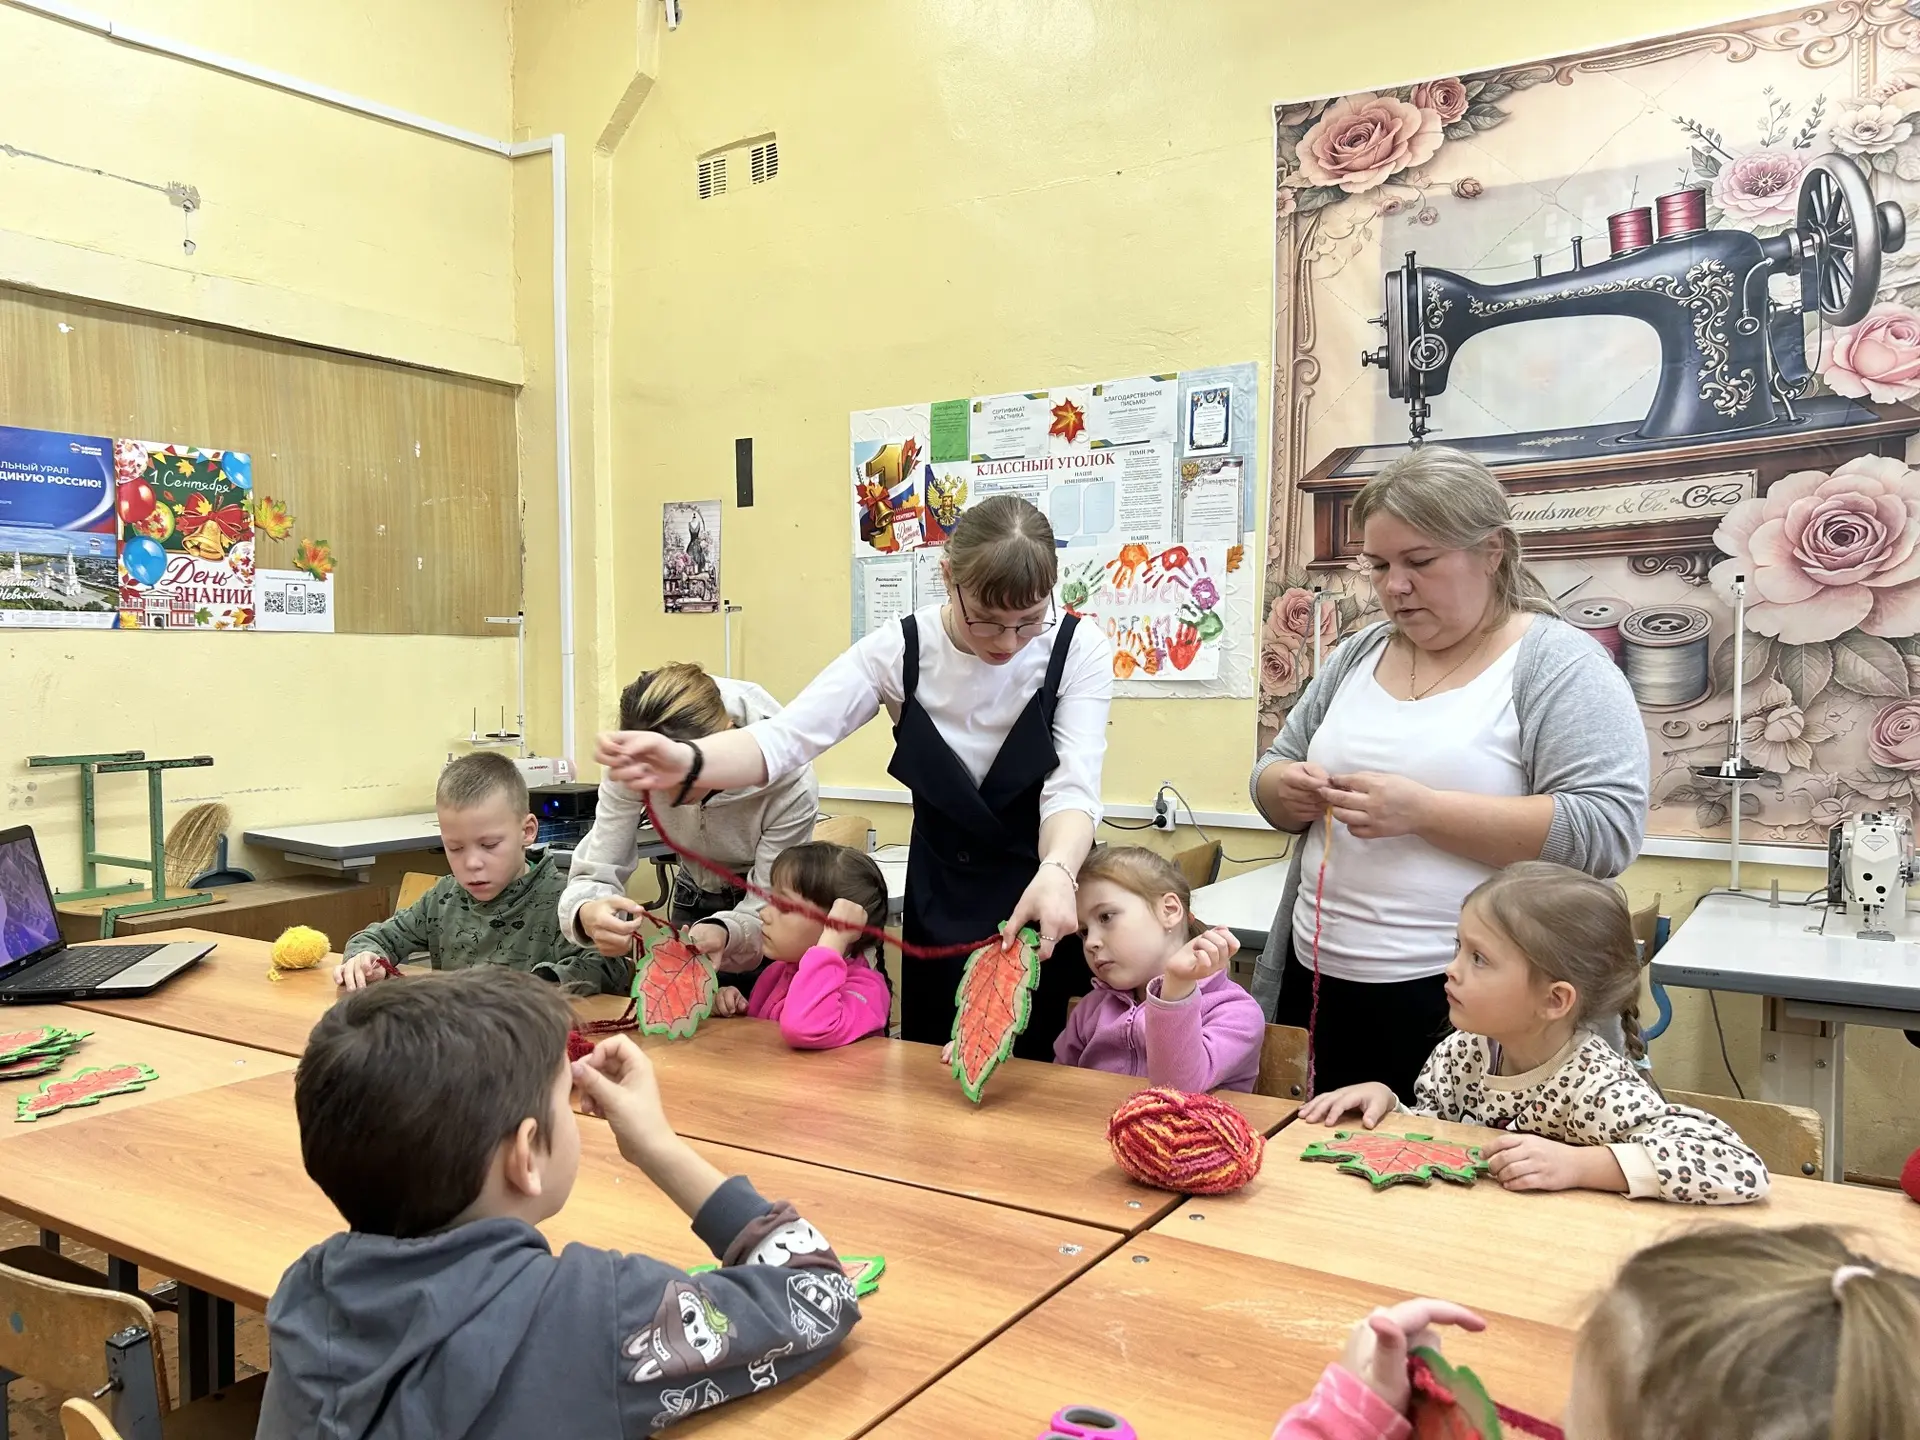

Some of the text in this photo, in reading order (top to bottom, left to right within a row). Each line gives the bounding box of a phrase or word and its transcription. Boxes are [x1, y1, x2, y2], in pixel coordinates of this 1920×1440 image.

[1104, 390, 1162, 402] БЛАГОДАРСТВЕННОЕ
[1120, 399, 1146, 407] ПИСЬМО
[0, 461, 70, 475] ЛЬНЫЙ УРАЛ!
[976, 452, 1116, 476] КЛАССНЫЙ УГОЛОК
[47, 475, 102, 488] РОССИЮ!
[163, 470, 231, 494] Сентября
[1615, 498, 1635, 514] &
[160, 556, 234, 586] День
